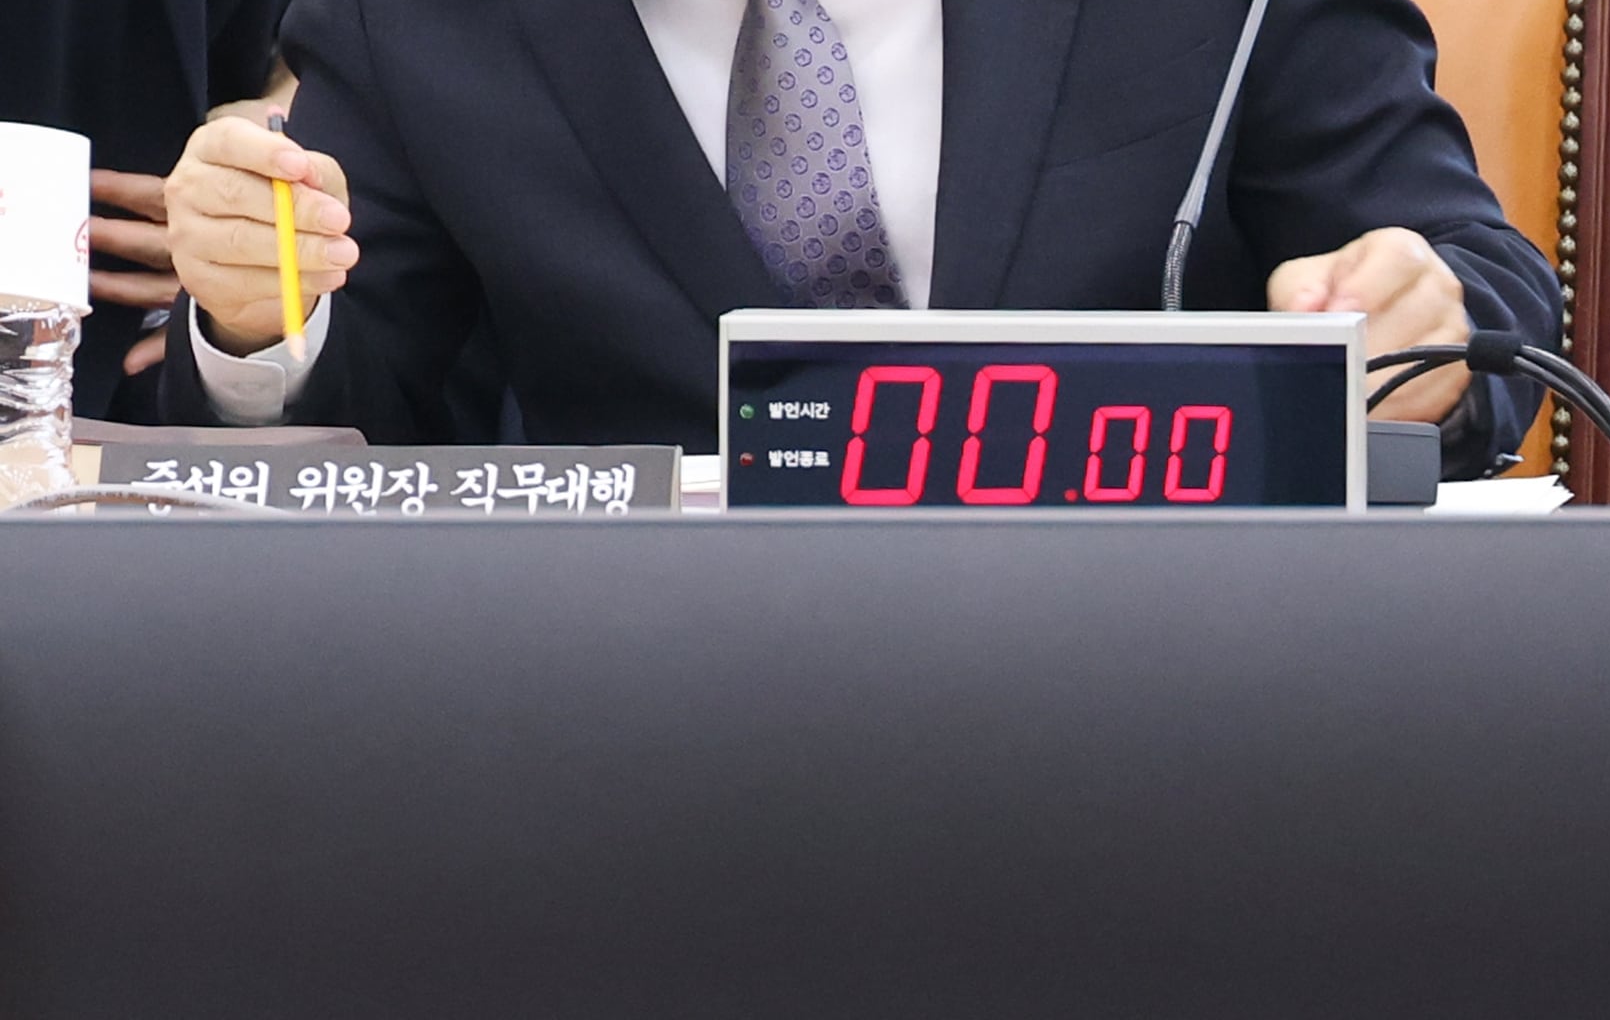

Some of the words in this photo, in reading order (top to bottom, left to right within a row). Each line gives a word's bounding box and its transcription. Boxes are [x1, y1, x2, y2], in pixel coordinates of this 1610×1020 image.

[768, 401, 831, 419] 발언시간
[768, 449, 831, 468] 발언종료
[290, 461, 438, 517] 위원장
[450, 462, 637, 517] 직무대행
